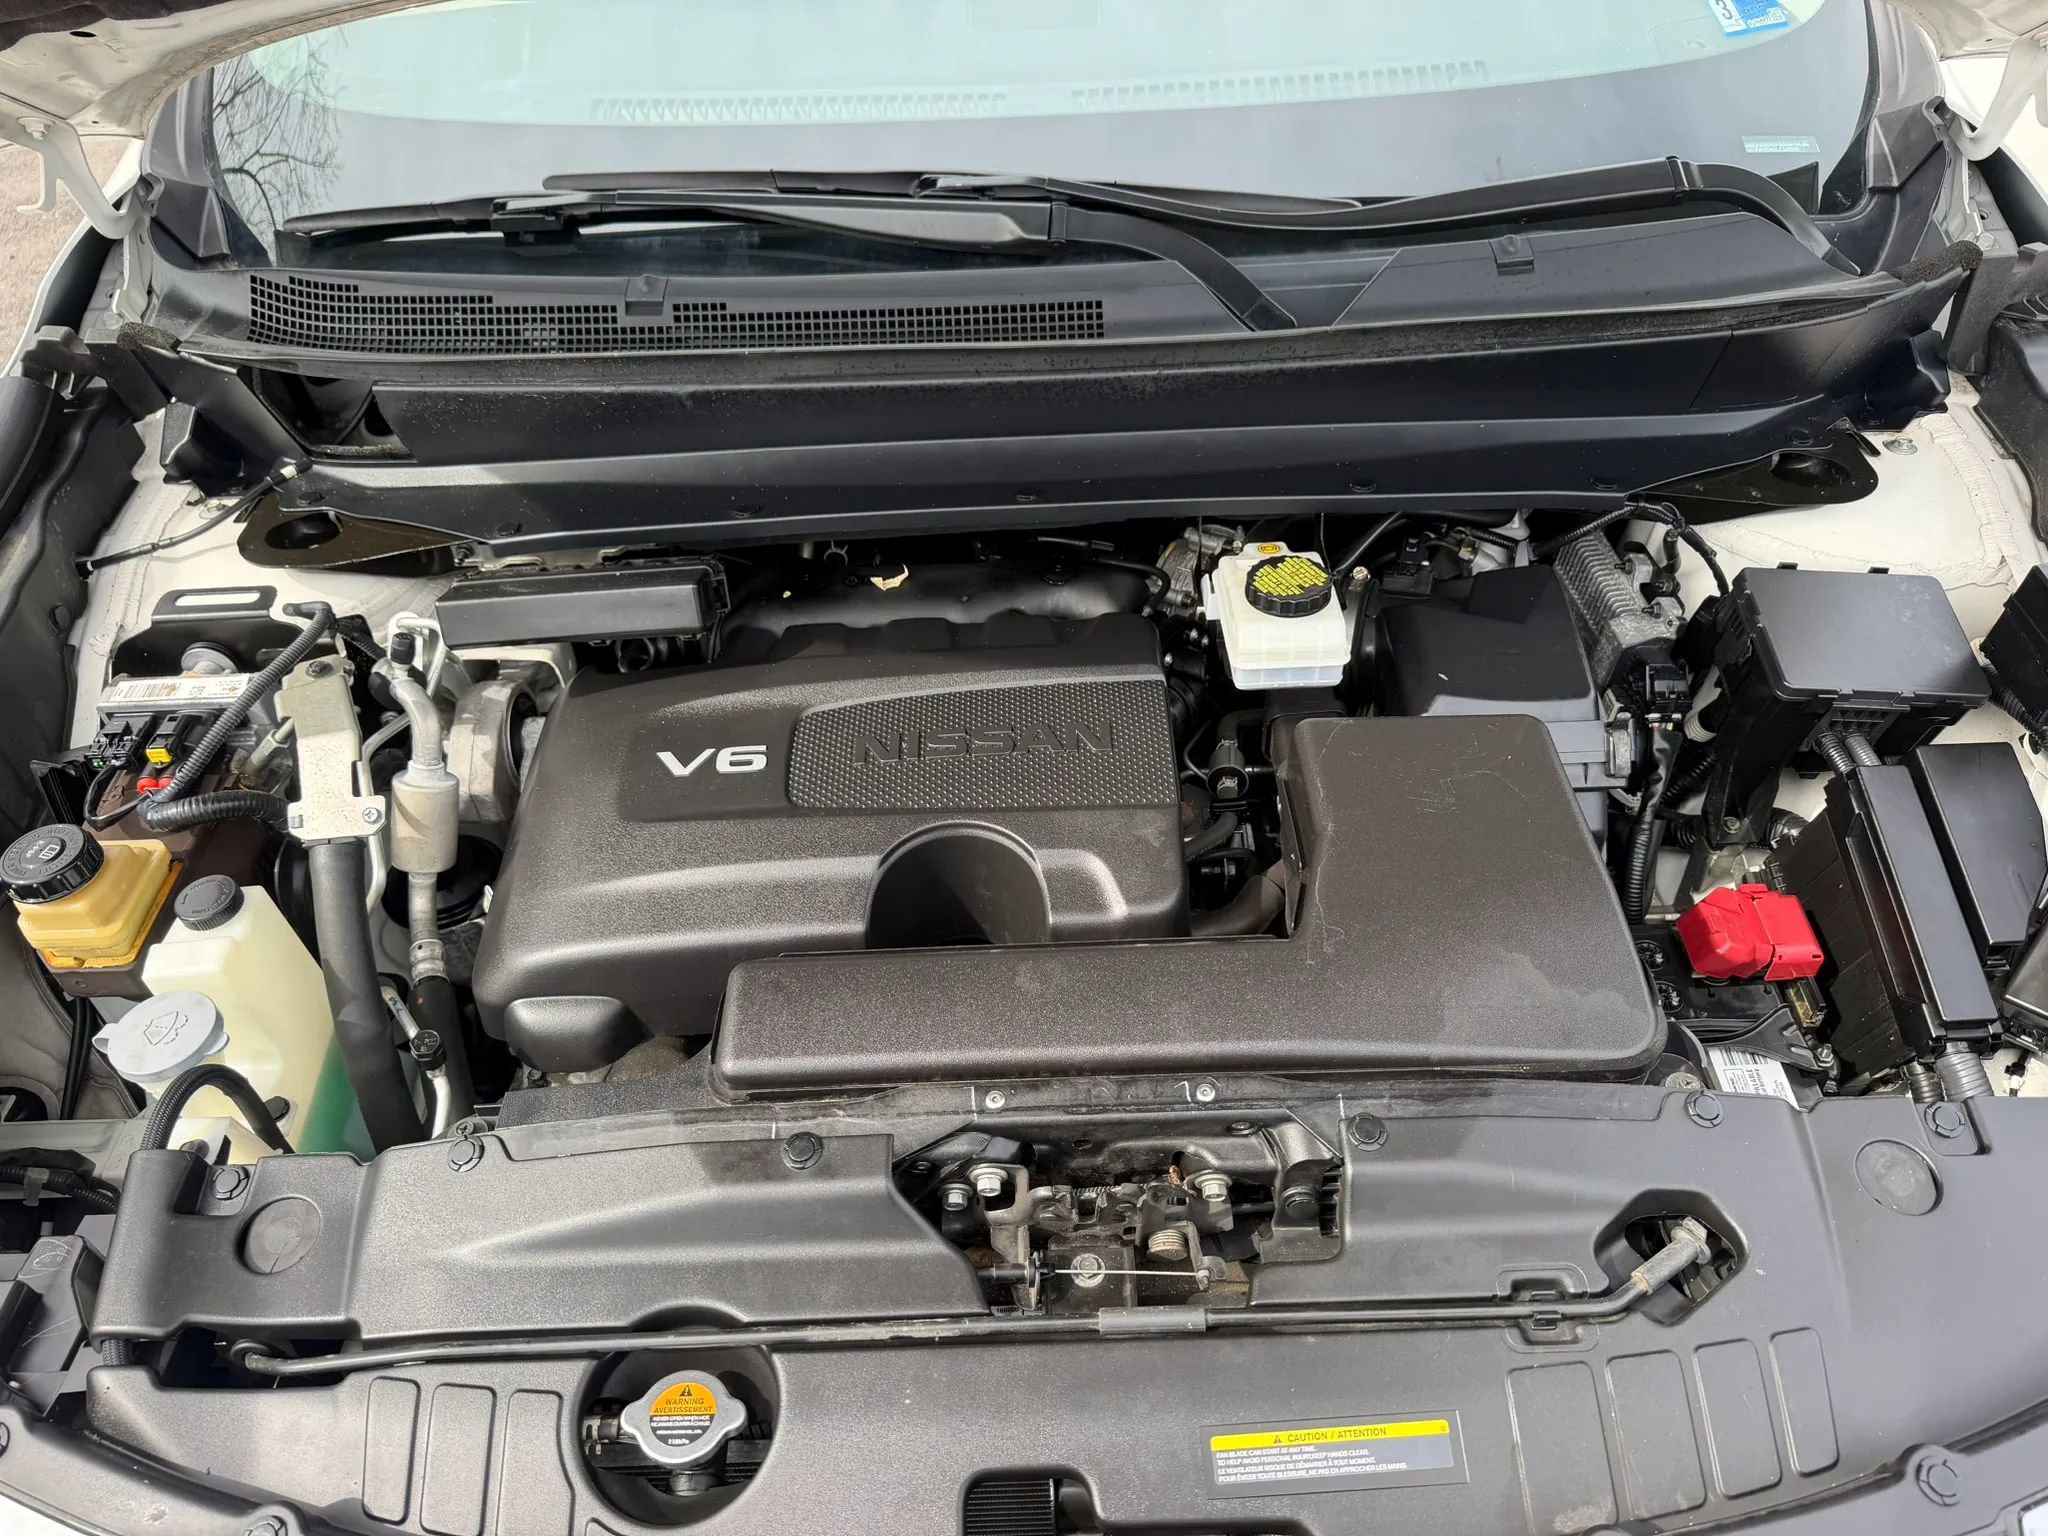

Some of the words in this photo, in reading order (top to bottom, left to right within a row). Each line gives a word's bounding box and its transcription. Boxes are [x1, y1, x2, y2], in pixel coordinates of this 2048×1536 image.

[851, 722, 1113, 766] NISSAN
[656, 745, 767, 777] V6
[1288, 1432, 1328, 1443] CAUTION
[1337, 1427, 1386, 1440] ATTENTION
